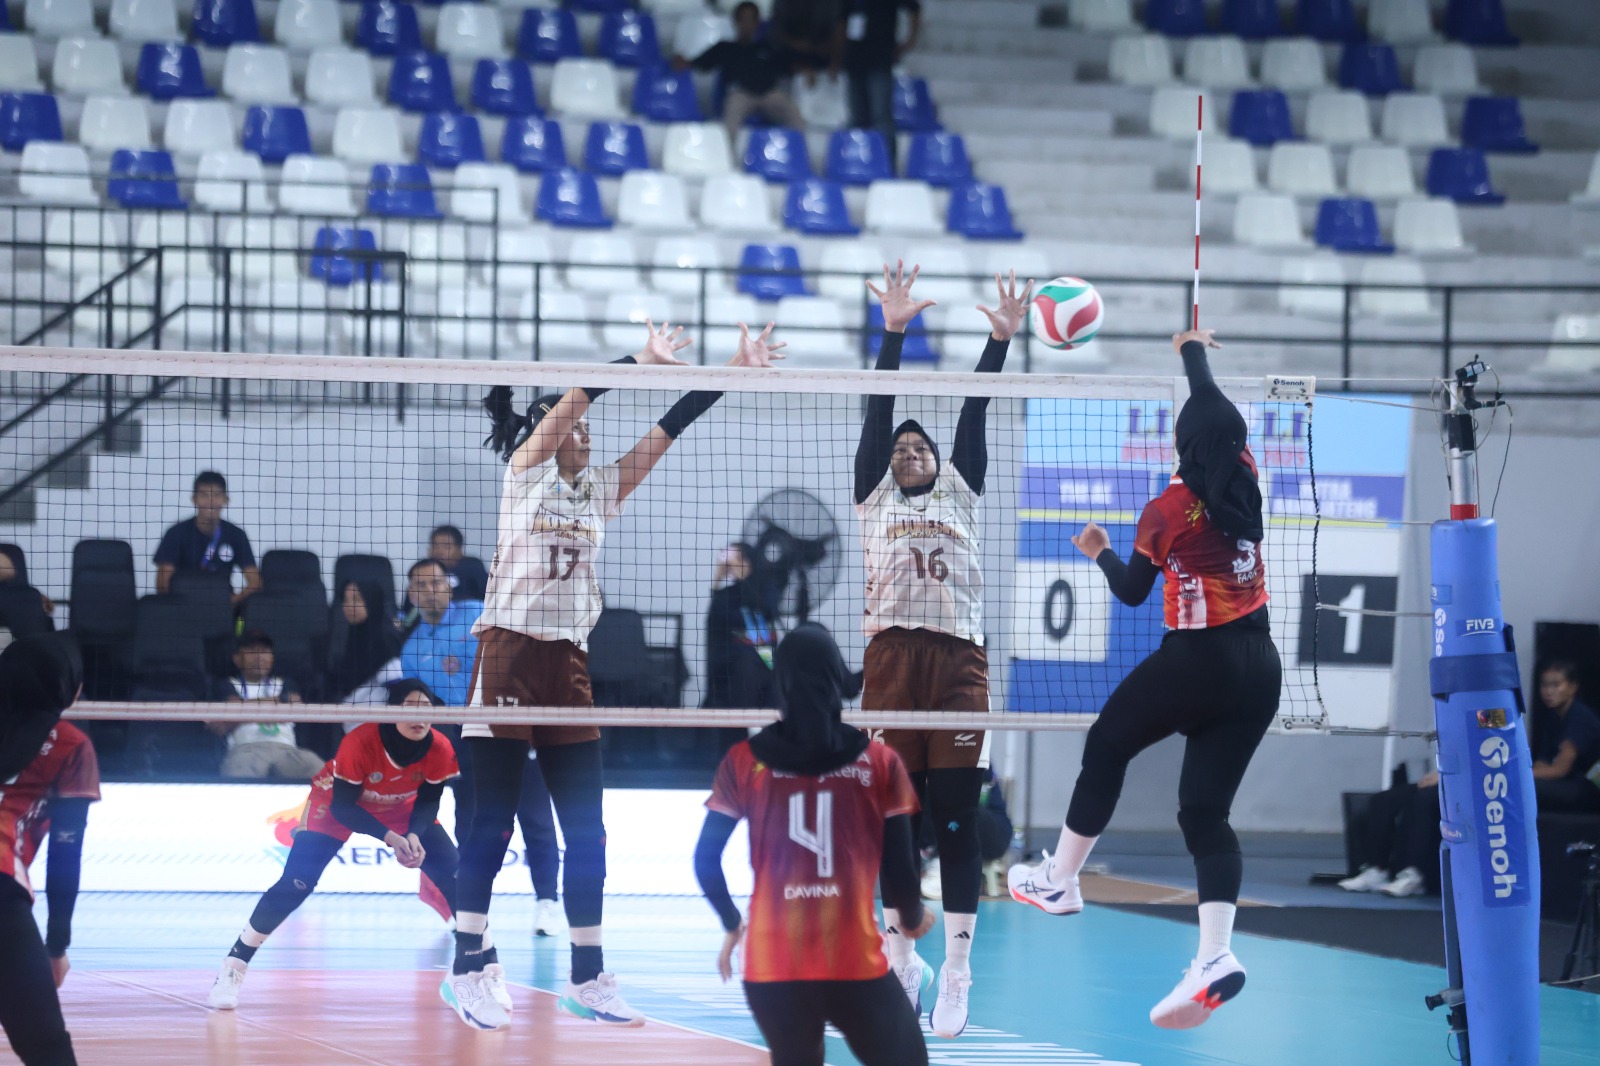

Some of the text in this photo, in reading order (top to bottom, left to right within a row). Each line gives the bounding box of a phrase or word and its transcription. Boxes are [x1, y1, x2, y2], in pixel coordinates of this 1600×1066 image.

[549, 545, 580, 581] 17
[909, 547, 949, 582] 16
[789, 791, 832, 878] 4
[1483, 772, 1517, 899] Senoh
[784, 884, 839, 899] DAVINA
